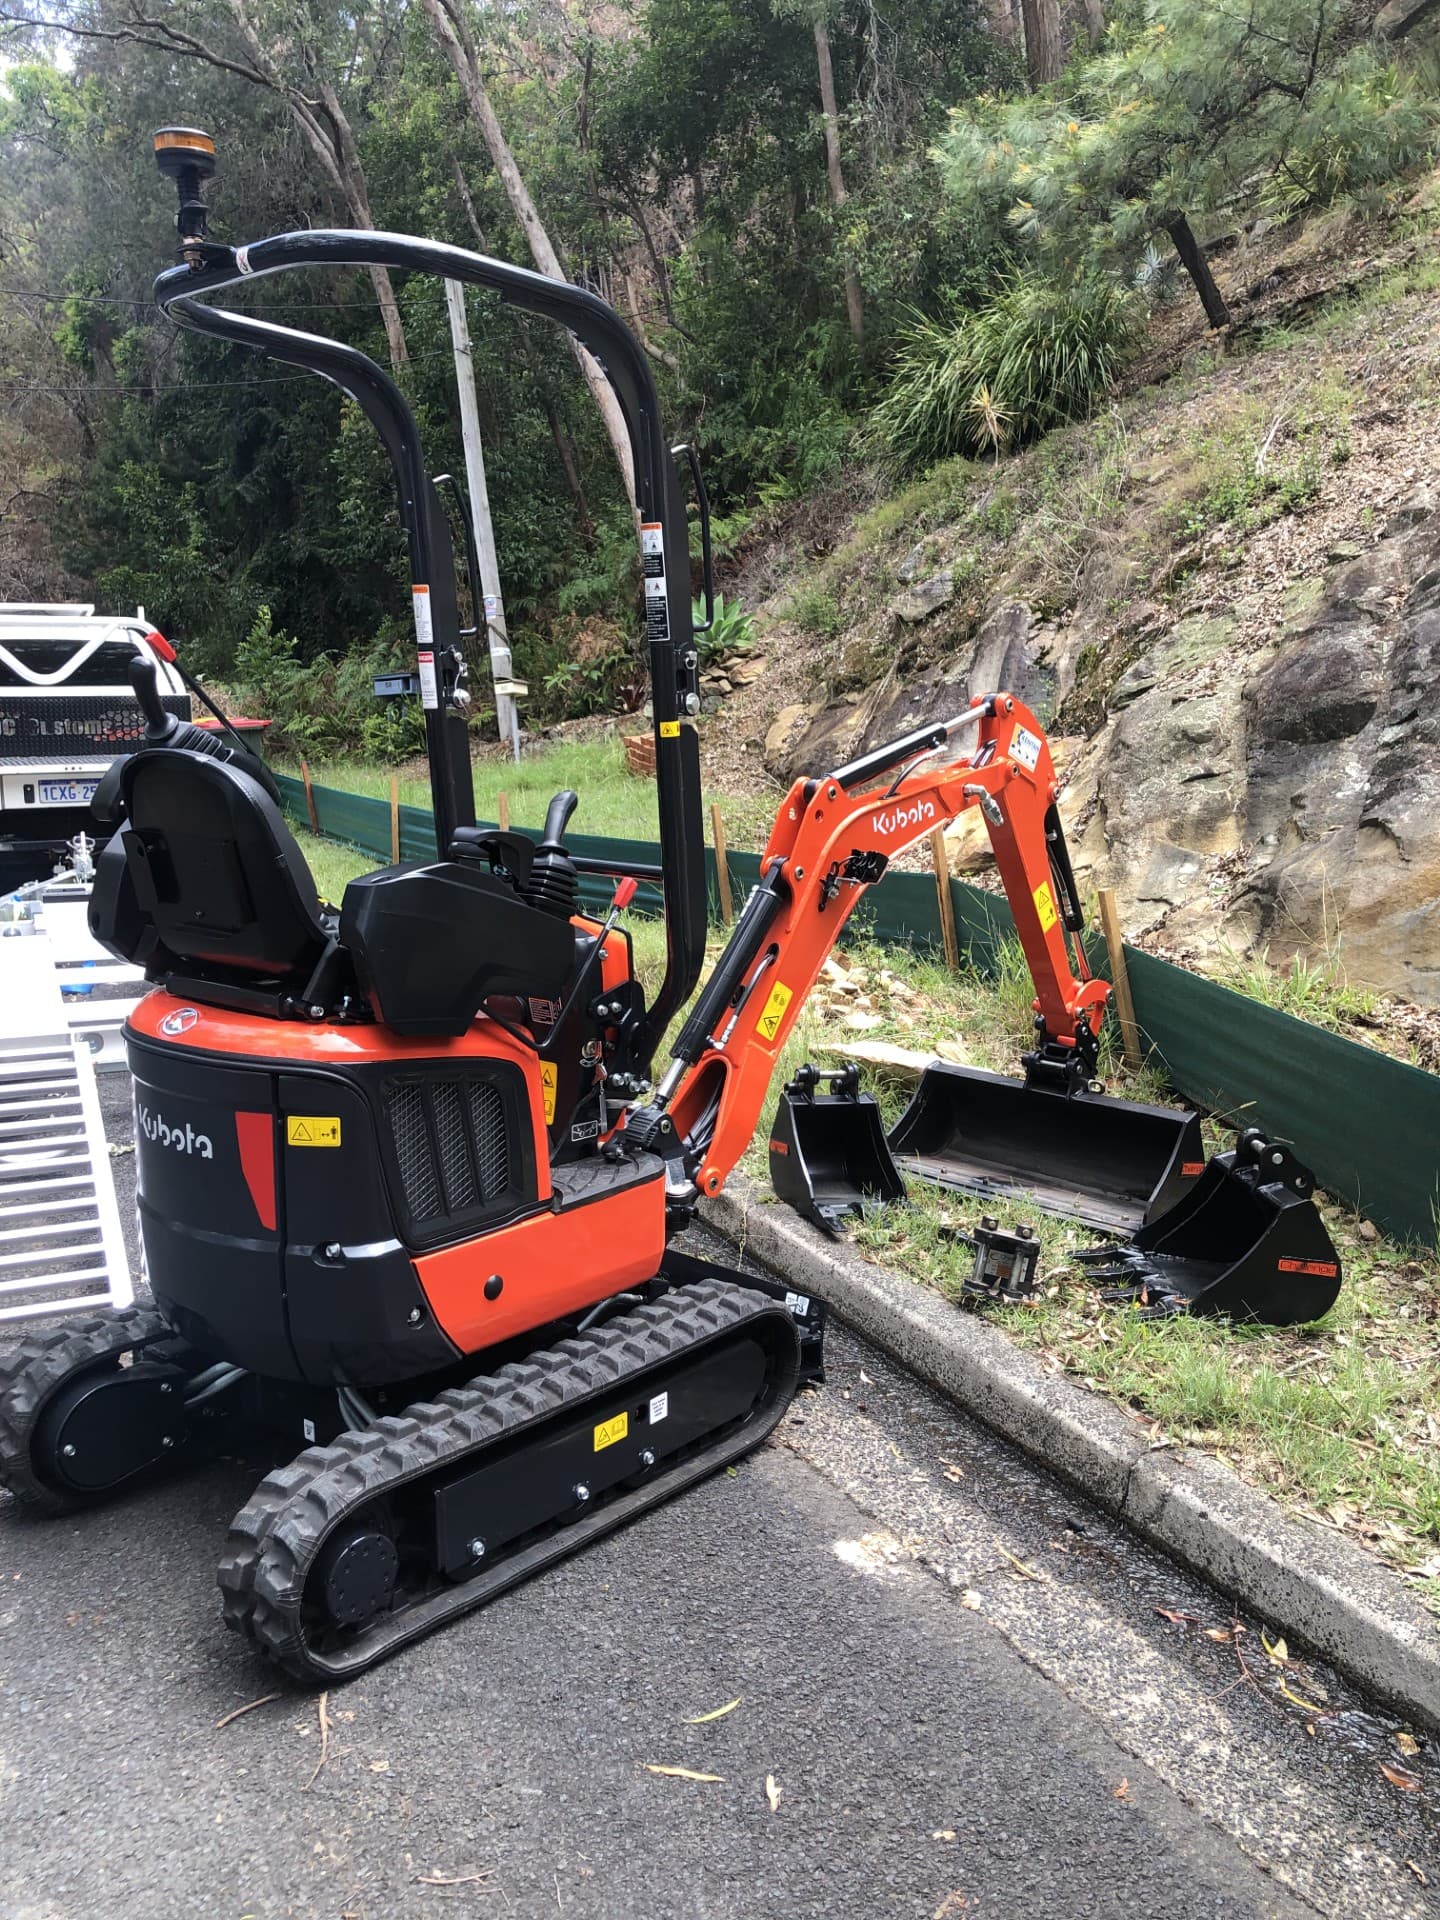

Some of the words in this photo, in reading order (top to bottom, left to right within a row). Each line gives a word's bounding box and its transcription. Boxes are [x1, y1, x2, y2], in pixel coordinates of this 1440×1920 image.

[43, 786, 77, 801] 1CXG
[872, 800, 935, 836] Kubota
[138, 1103, 213, 1159] Kubota
